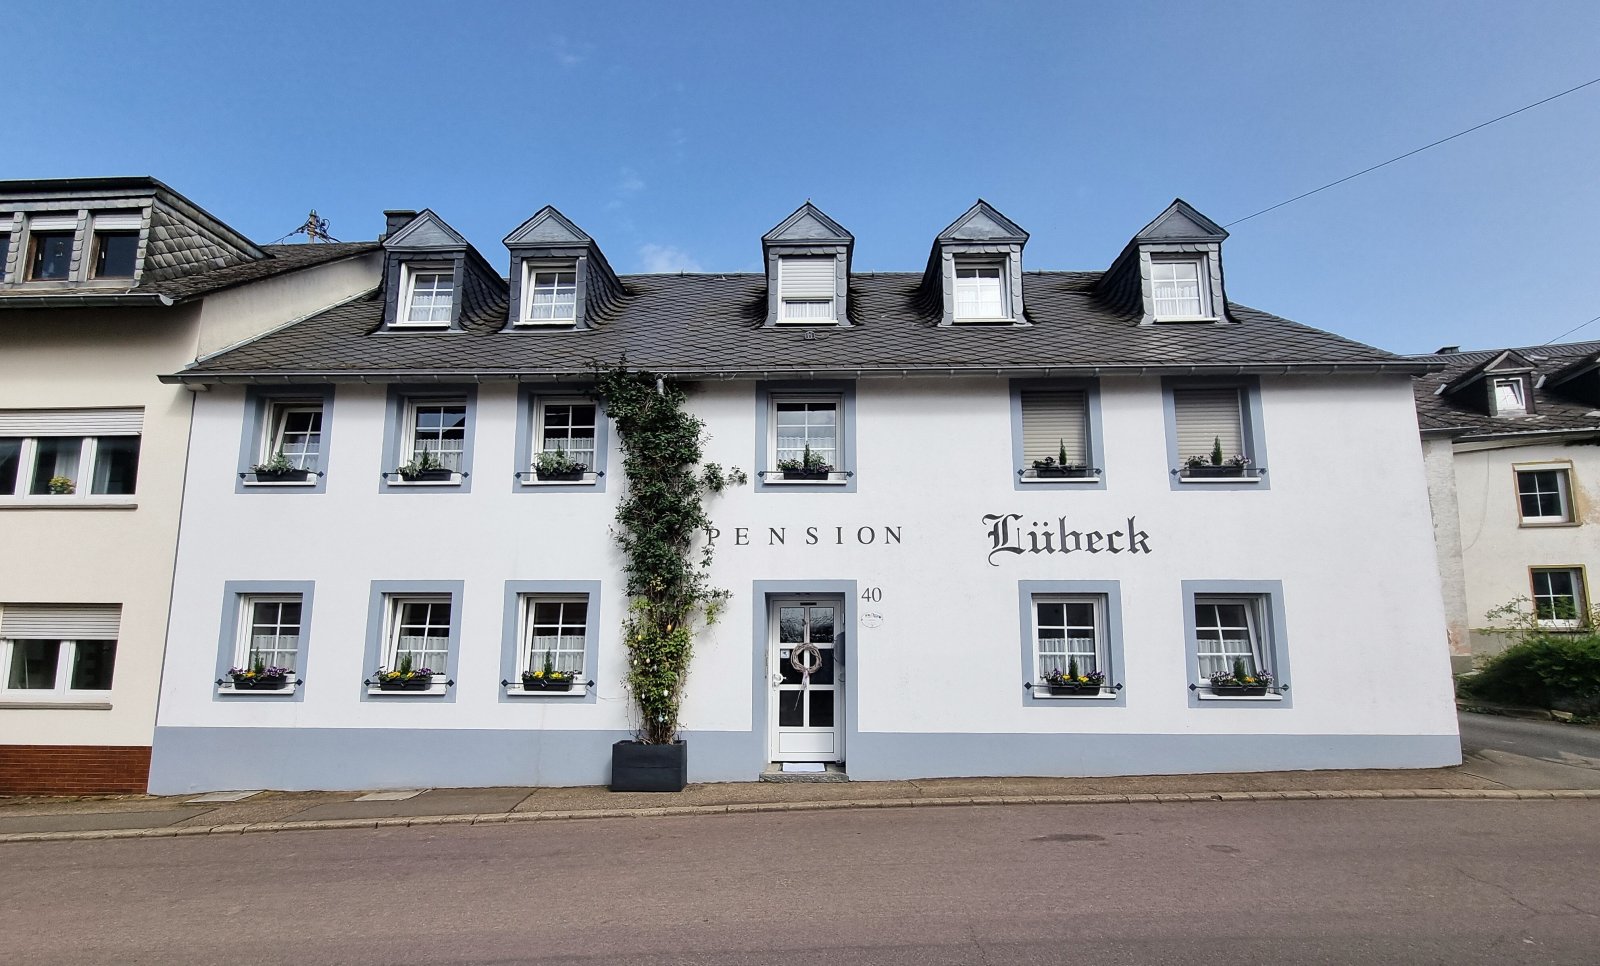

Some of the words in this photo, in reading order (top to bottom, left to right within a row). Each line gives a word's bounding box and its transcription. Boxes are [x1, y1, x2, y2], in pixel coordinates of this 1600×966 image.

[706, 526, 902, 546] PENSION
[982, 513, 1152, 566] Lübeck
[861, 587, 882, 602] 40
